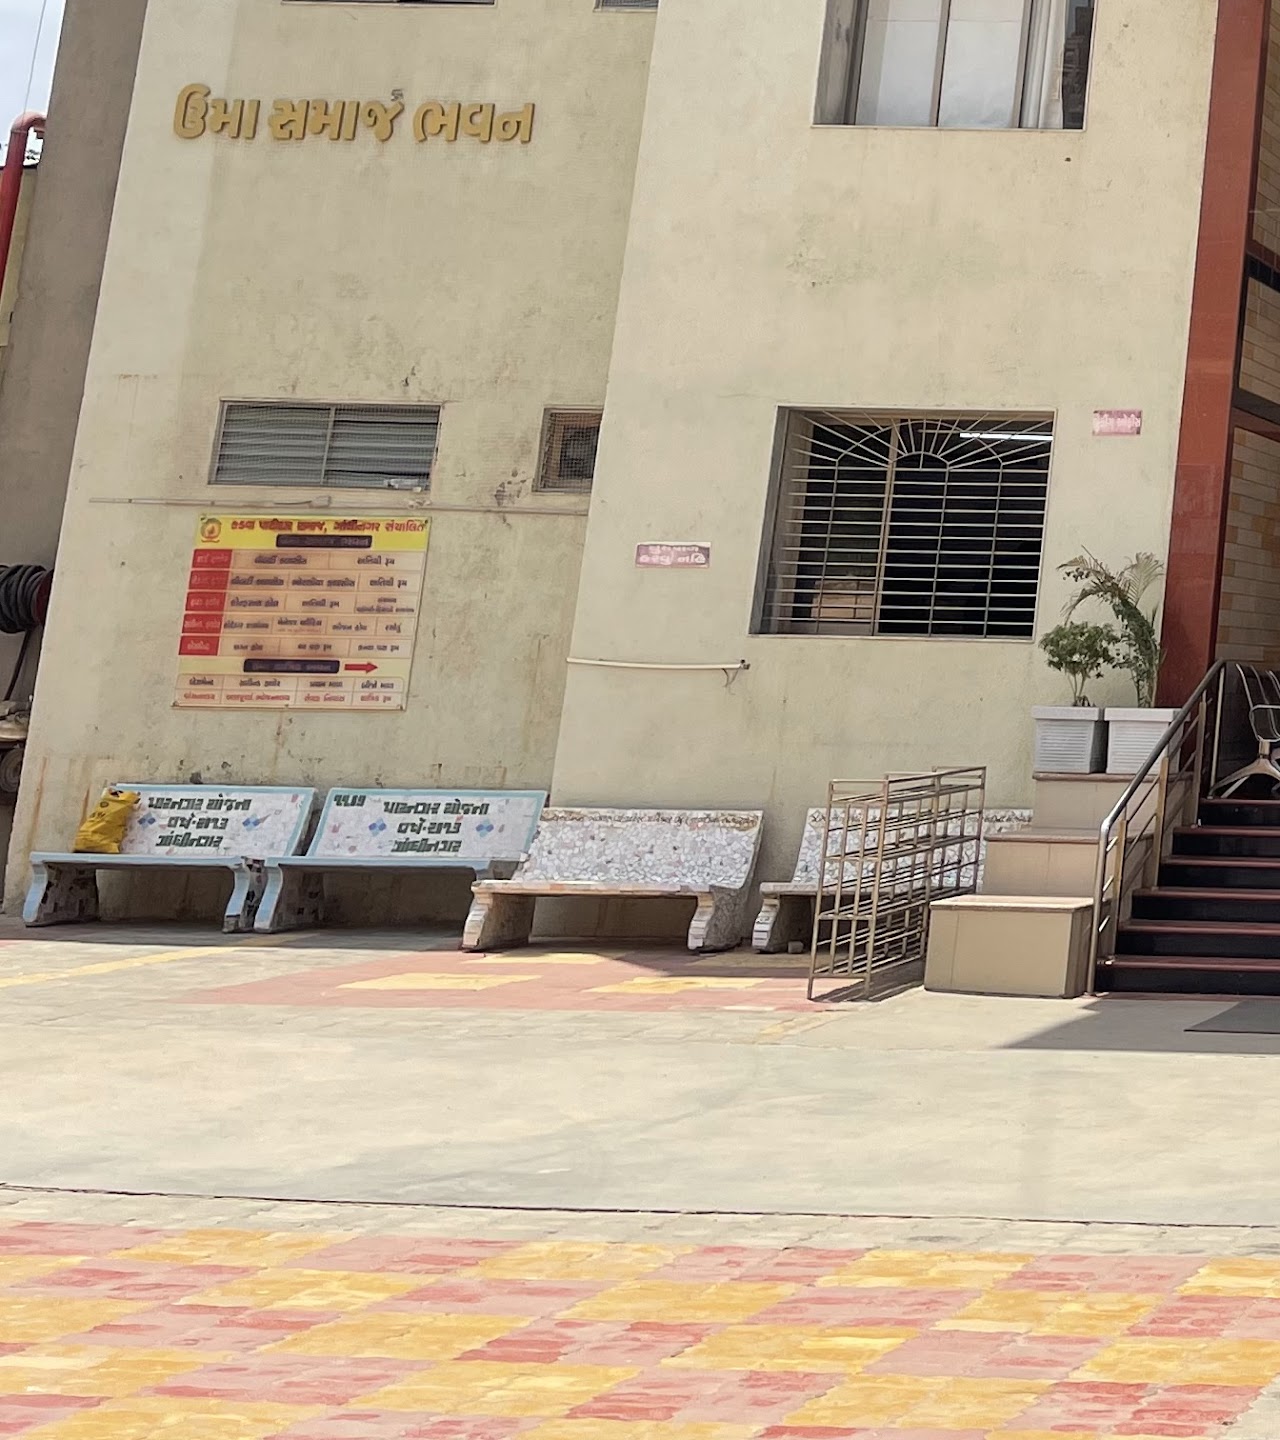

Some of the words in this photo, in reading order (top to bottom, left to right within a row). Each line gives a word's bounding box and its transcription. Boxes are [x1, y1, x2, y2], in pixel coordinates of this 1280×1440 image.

[173, 83, 261, 140] ઉમા
[267, 100, 405, 142] સમાજ
[412, 101, 536, 144] ભવન
